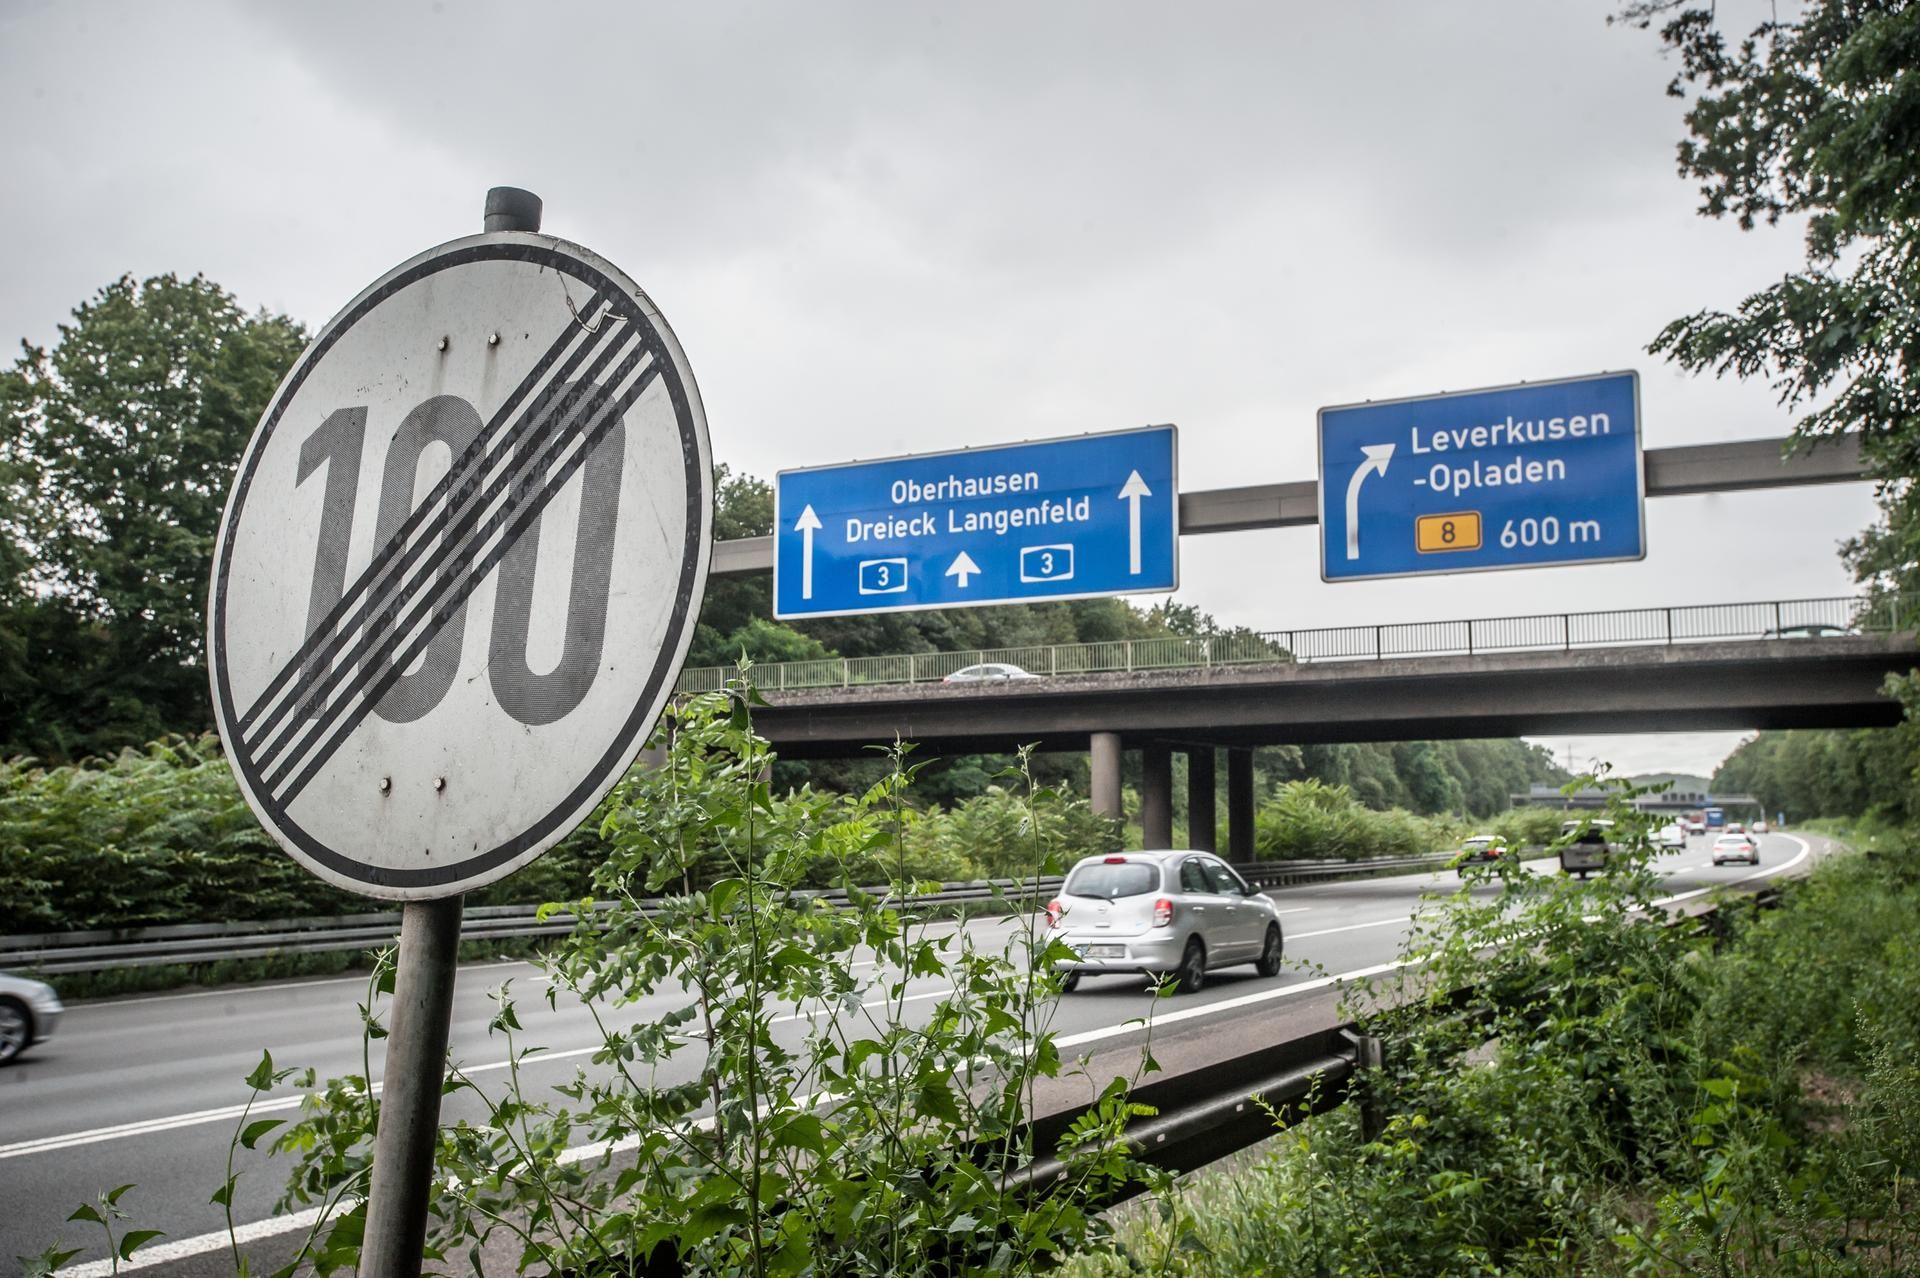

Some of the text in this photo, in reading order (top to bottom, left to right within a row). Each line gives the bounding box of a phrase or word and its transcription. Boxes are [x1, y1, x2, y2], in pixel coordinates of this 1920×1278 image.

[1411, 412, 1610, 455] Leverkusen
[891, 471, 1039, 505] Oberhausen
[1413, 455, 1566, 497] -Opladen
[846, 496, 1090, 543] Dreieck Langenfeld
[1441, 521, 1456, 544] 8
[1500, 516, 1601, 548] 600 m
[292, 380, 626, 726] 100
[1040, 552, 1053, 573] 3
[877, 566, 889, 587] 3
